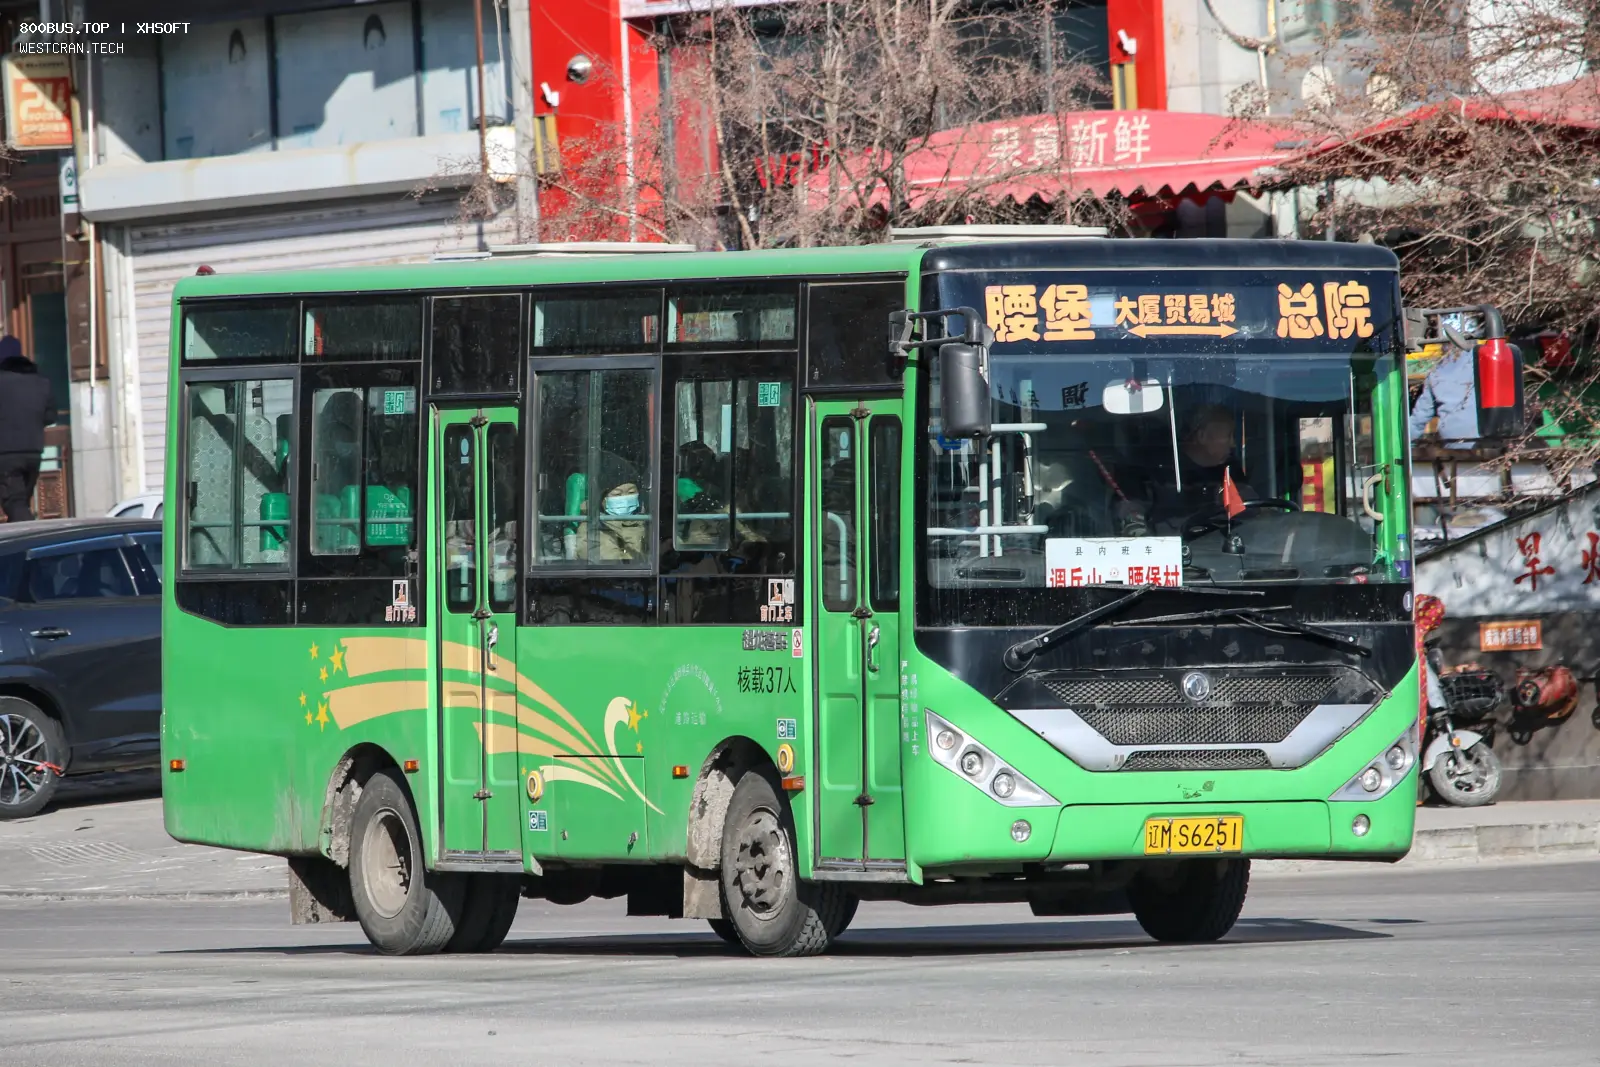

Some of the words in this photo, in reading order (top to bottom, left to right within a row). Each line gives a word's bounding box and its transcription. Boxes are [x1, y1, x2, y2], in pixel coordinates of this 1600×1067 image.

[985, 283, 1096, 342] 腰堡
[1114, 293, 1237, 325] 大厦贸易城
[1276, 280, 1374, 340] 总院
[760, 605, 793, 622] 前门上车
[737, 666, 797, 693] 核载37人
